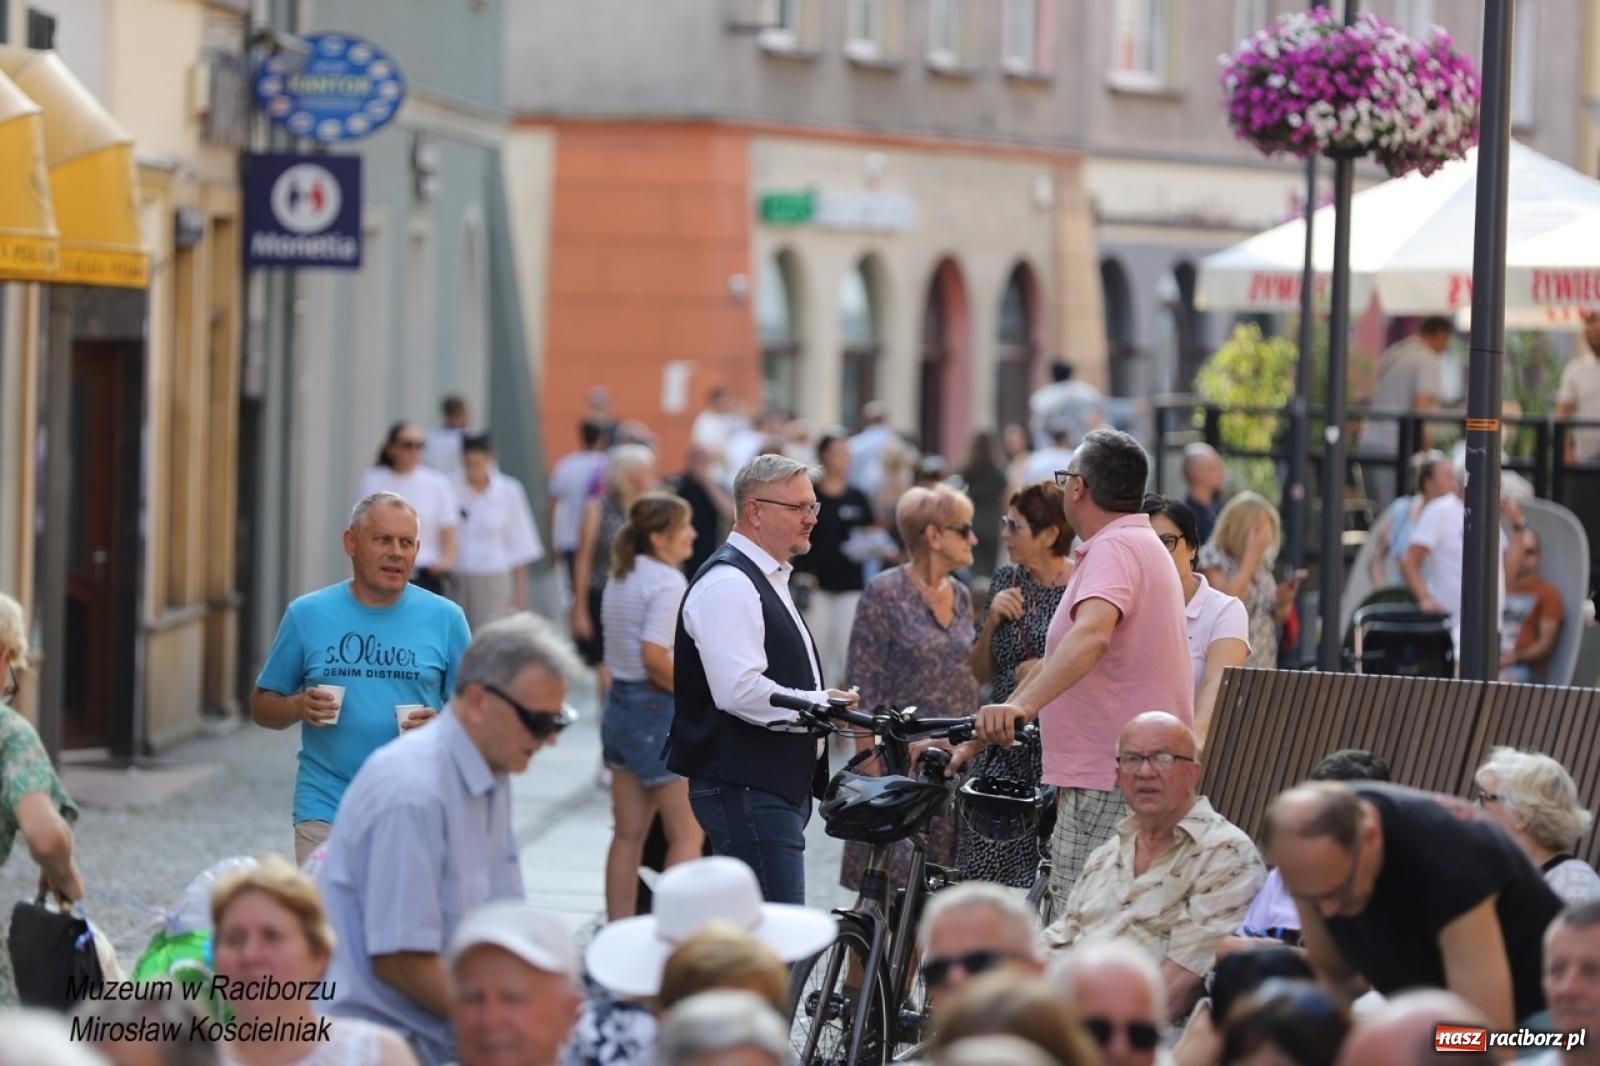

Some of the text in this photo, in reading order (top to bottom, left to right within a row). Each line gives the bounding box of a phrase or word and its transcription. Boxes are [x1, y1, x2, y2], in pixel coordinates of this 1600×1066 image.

[325, 631, 419, 668] s.Oliver
[323, 668, 421, 680] DENIM DISTRICT
